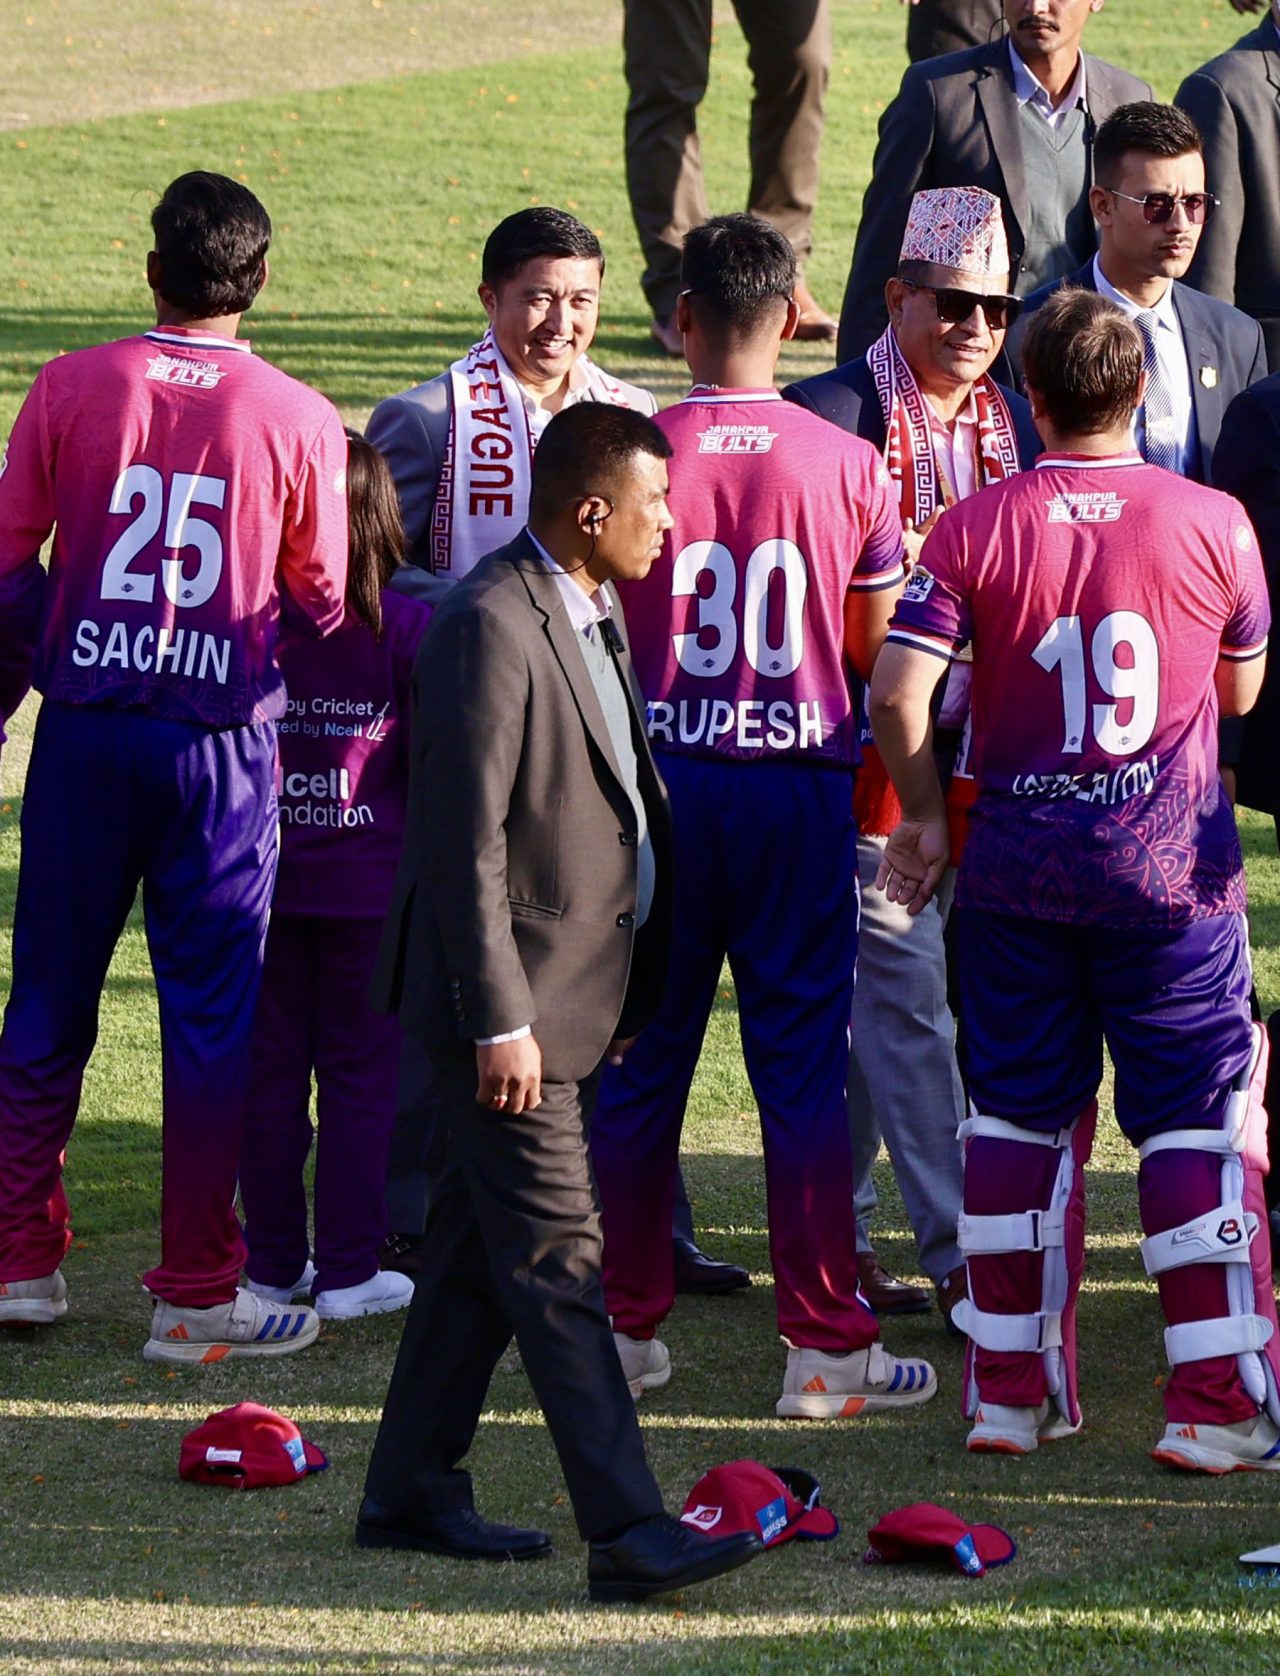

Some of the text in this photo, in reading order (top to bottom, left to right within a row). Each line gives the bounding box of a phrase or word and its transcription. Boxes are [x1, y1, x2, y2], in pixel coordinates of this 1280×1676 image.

[155, 354, 220, 371] JANAKPUR
[147, 361, 223, 388] BOLTS
[705, 425, 769, 434] JANAKPUR
[700, 433, 774, 452] BOLTS
[1048, 502, 1121, 521] BOLTS
[100, 464, 227, 609] 25
[671, 537, 808, 679] 30
[71, 619, 232, 685] SACHIN
[1030, 610, 1161, 756] 19
[311, 698, 375, 716] Cricket
[303, 720, 320, 738] by
[324, 722, 363, 737] Ncell
[647, 697, 824, 750] RUPESH
